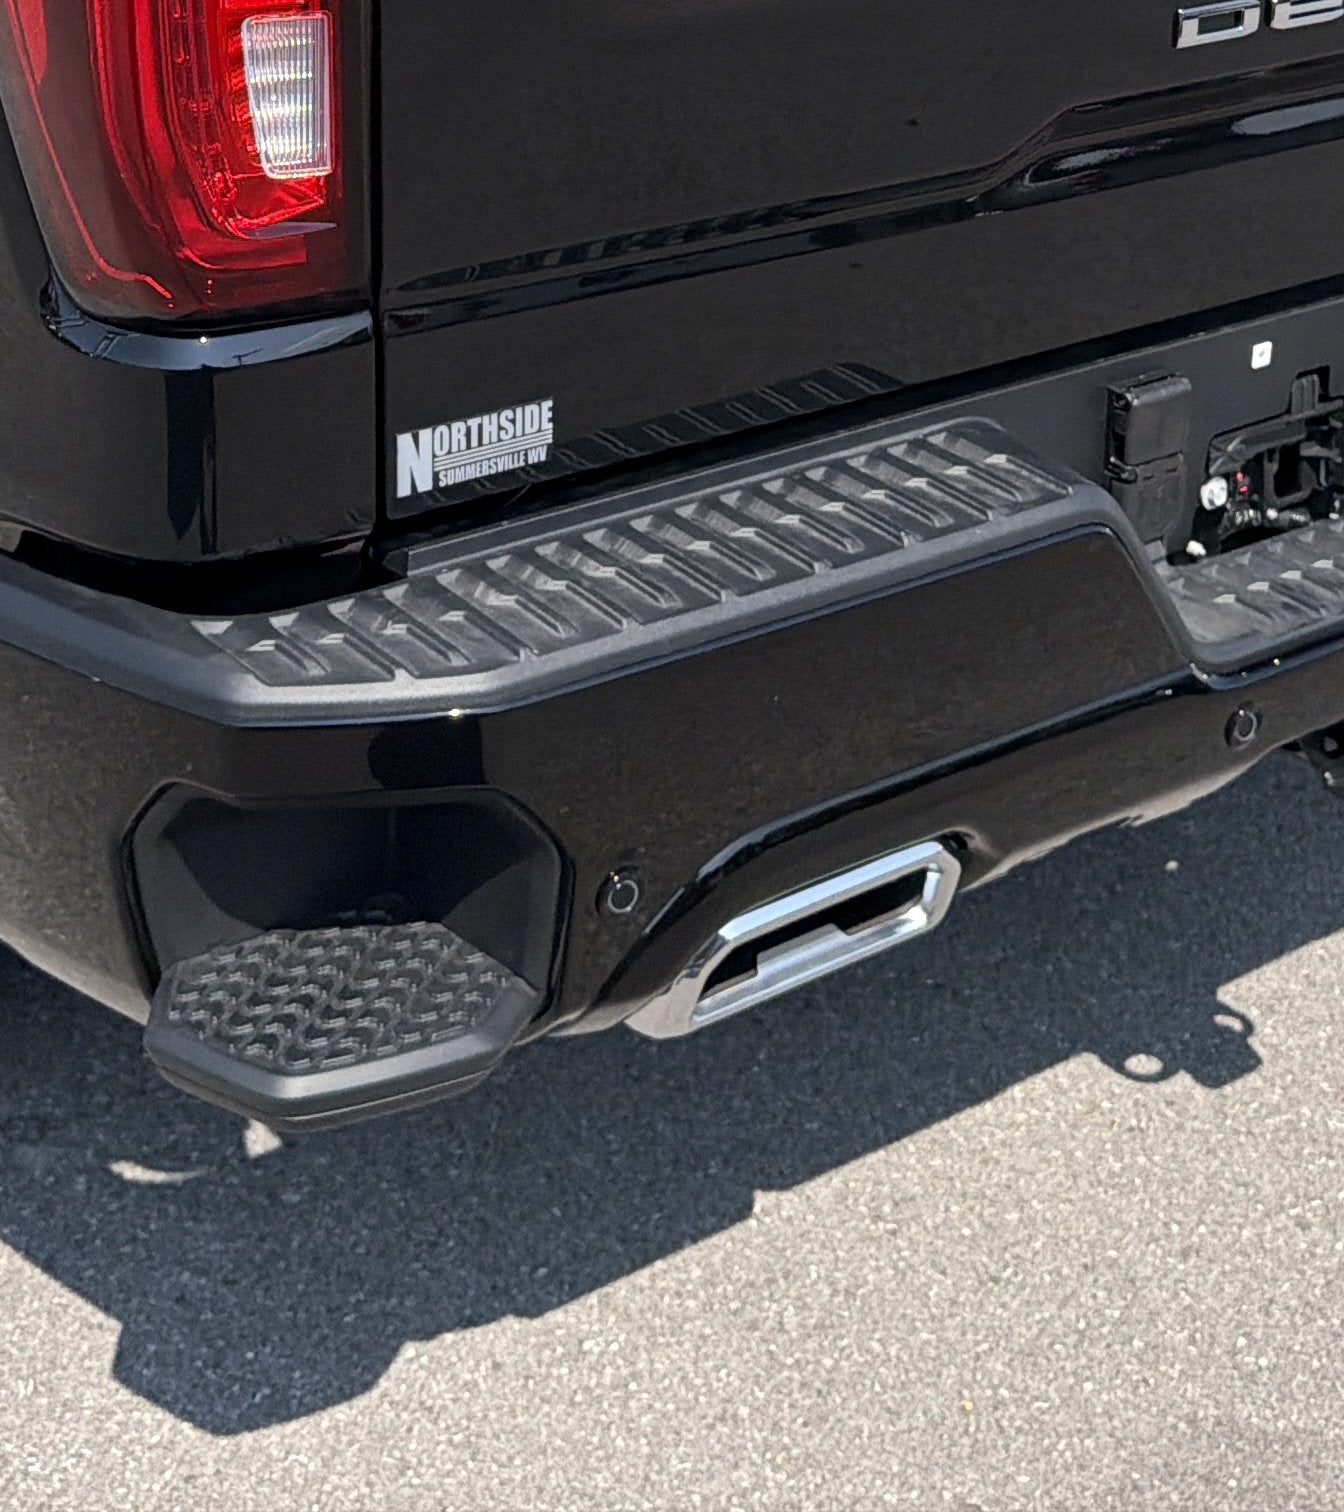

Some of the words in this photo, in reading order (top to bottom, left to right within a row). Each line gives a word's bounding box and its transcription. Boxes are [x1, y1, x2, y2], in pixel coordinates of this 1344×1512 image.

[396, 398, 553, 498] NORTHSIDE
[439, 450, 526, 487] SUMMERSVILLE
[527, 445, 548, 464] WV
